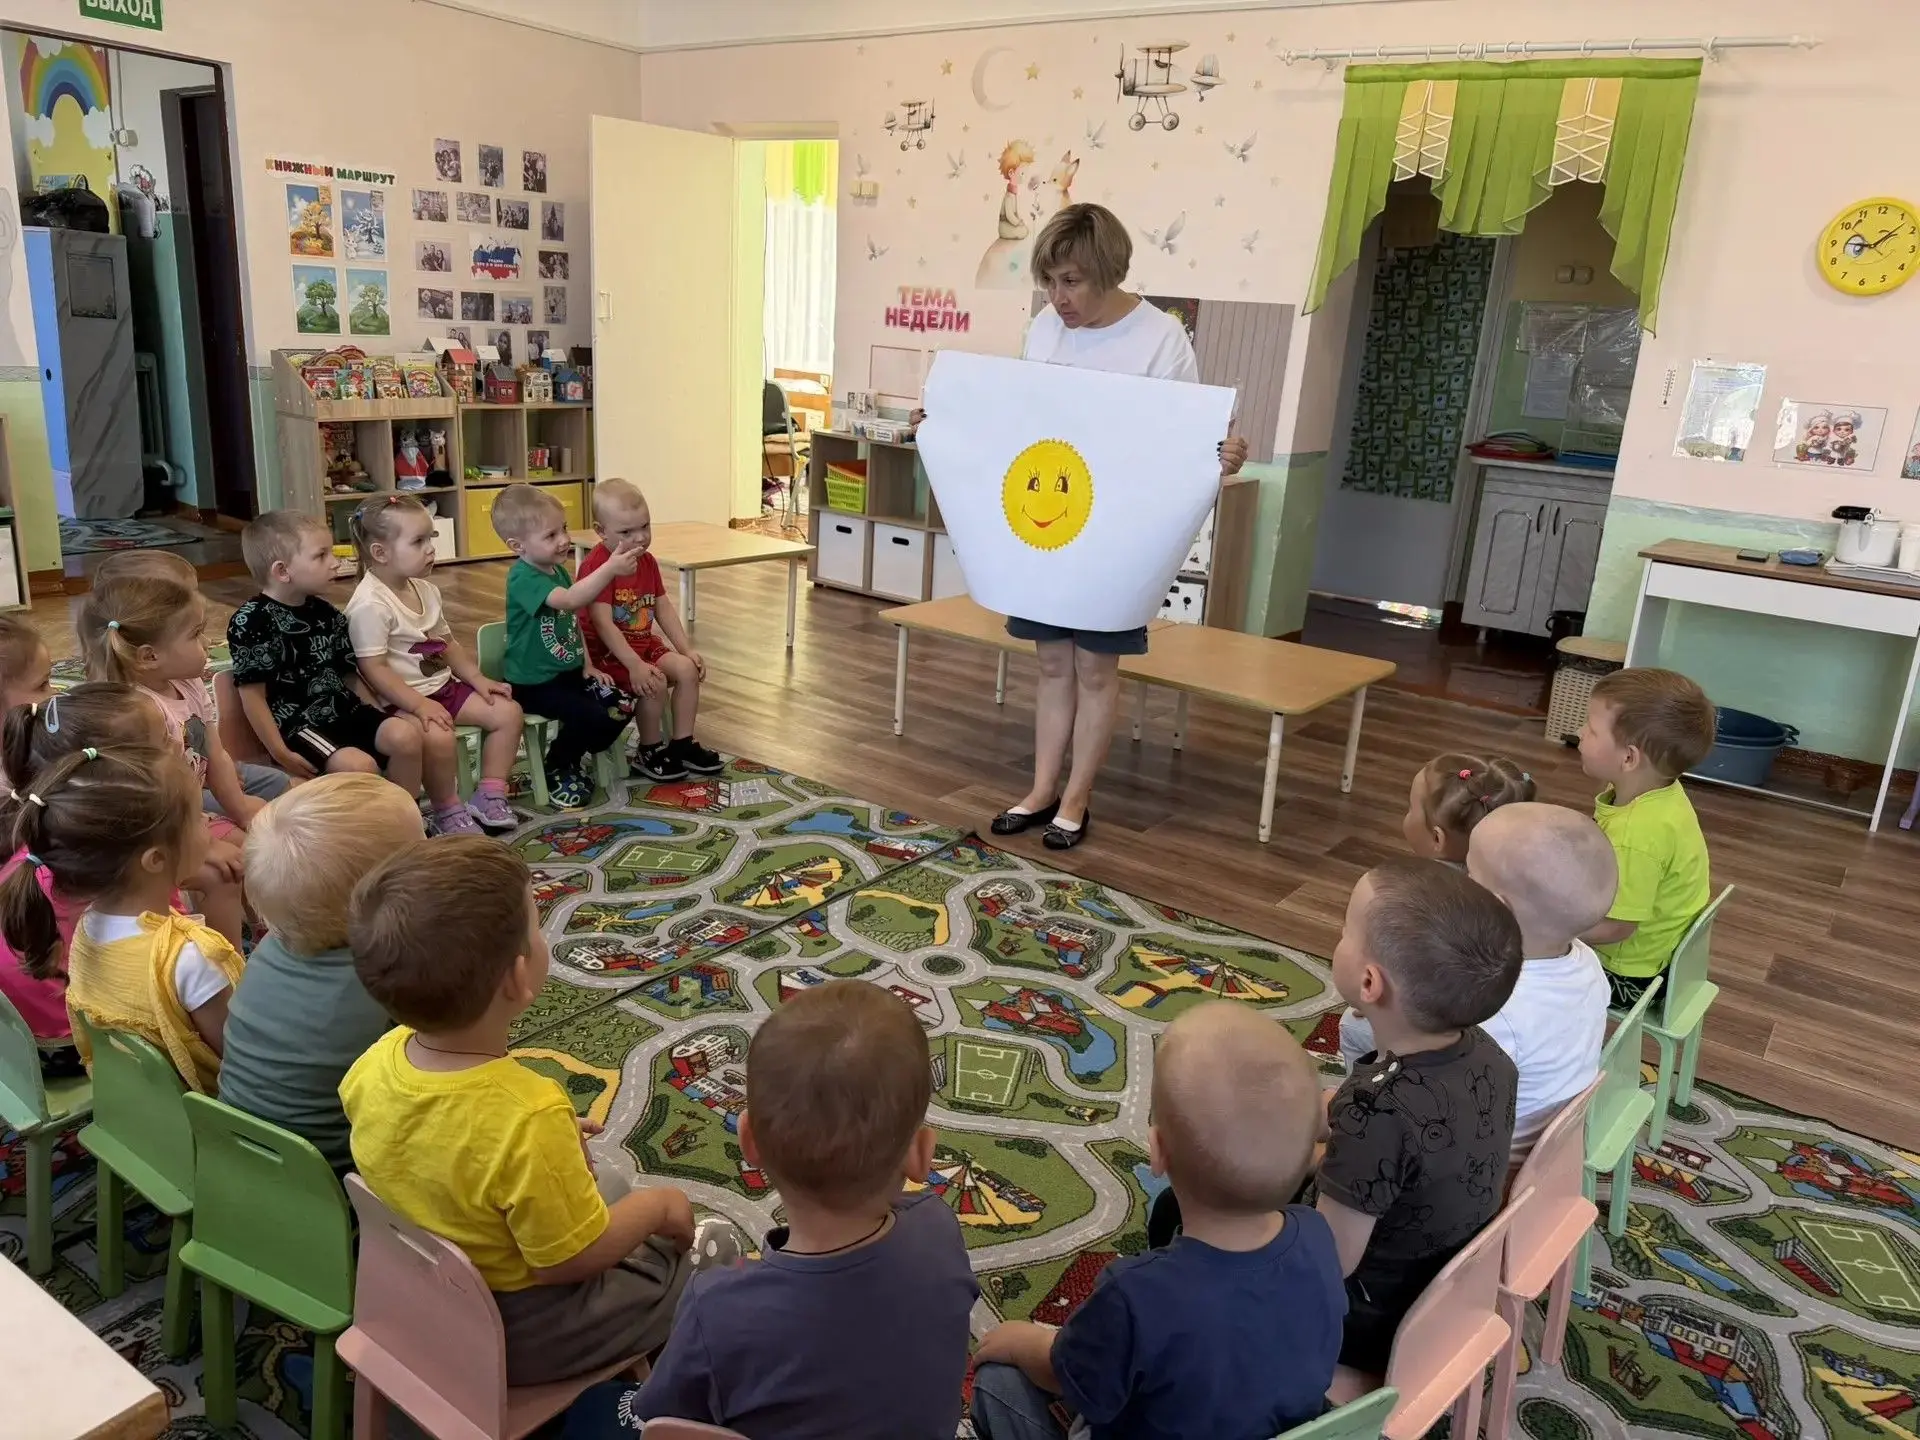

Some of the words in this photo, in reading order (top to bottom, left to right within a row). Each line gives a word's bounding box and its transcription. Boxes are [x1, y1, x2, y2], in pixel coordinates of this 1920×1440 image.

[336, 168, 395, 185] МАРШРУТ
[1877, 206, 1888, 214] 12
[1859, 210, 1868, 219] 11
[1900, 213, 1905, 221] 1
[1840, 222, 1851, 230] 10
[1909, 226, 1916, 234] 2
[1830, 239, 1837, 248] 9
[1909, 245, 1916, 253] 3
[1830, 257, 1837, 265] 8
[1898, 263, 1905, 271] 4
[1841, 272, 1848, 280] 7
[1880, 275, 1887, 283] 5
[1859, 278, 1865, 286] 6
[898, 286, 956, 308] ТЕМА
[885, 307, 969, 331] НЕДЕЛИ
